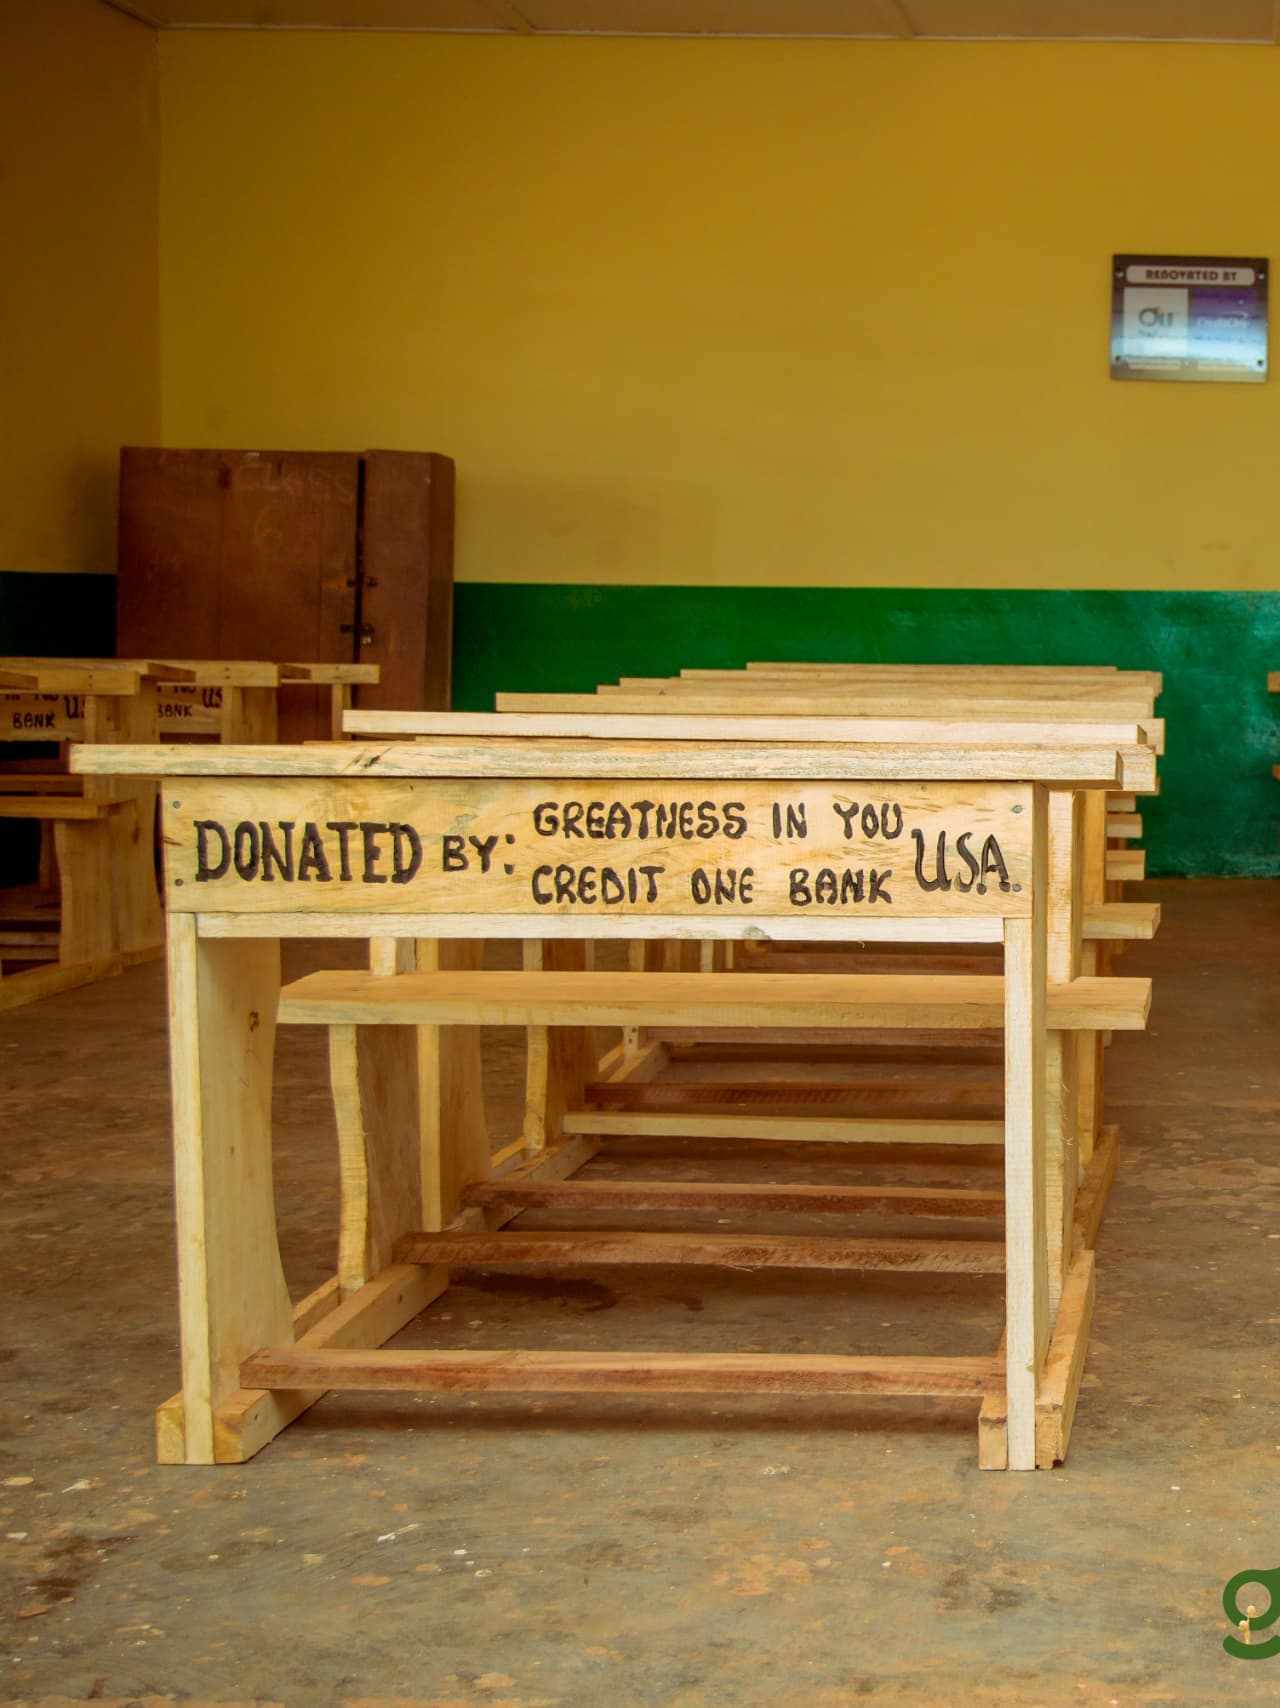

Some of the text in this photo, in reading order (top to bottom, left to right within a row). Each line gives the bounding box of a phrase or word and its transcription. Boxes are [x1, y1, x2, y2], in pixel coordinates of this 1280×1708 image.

[12, 711, 56, 729] BANK
[533, 800, 904, 840] GREATNESS IN YOU
[194, 820, 515, 884] DONATED BY:
[532, 864, 892, 906] CREDIT ONE BANK
